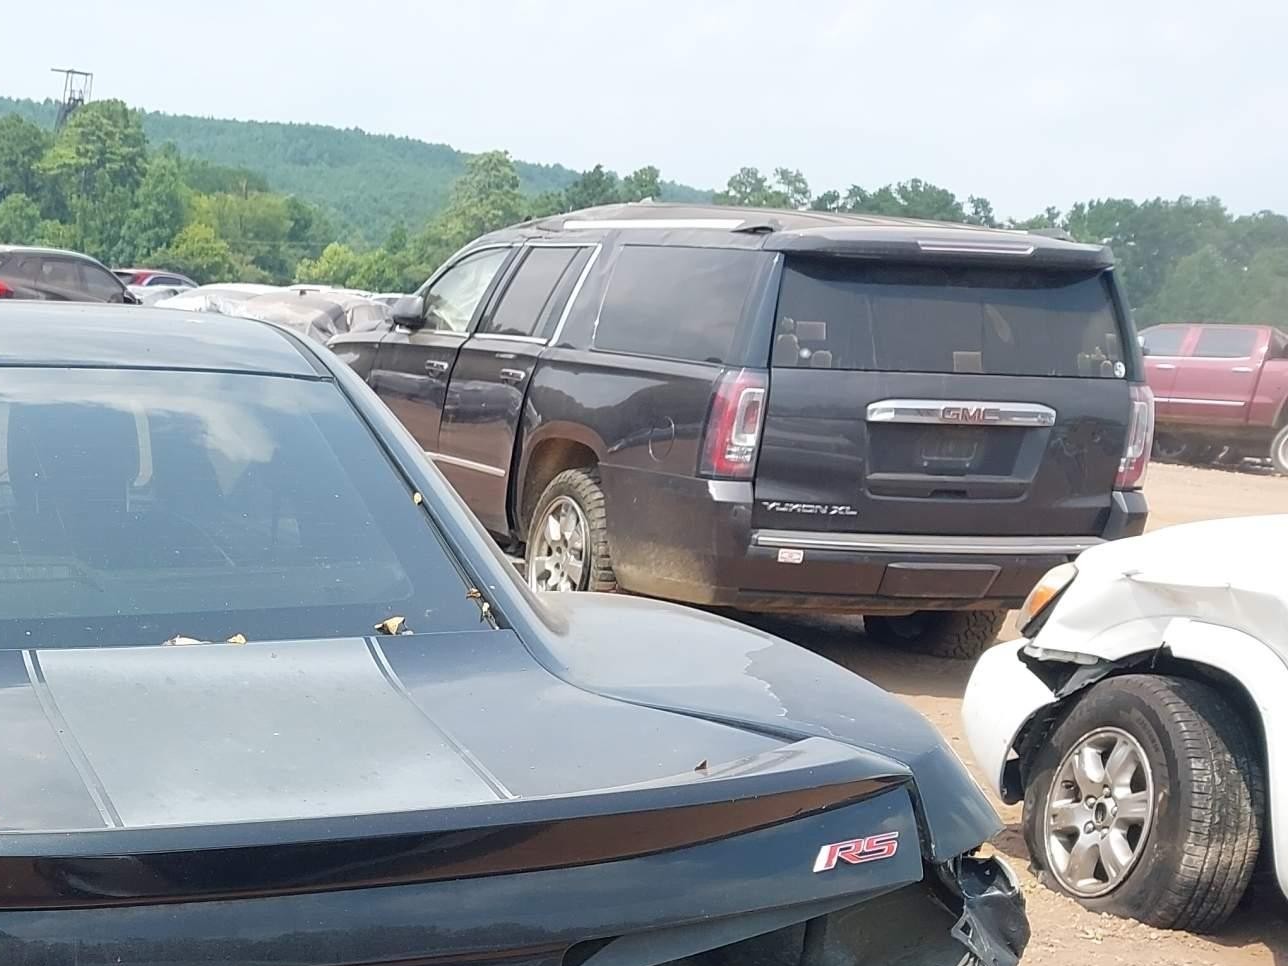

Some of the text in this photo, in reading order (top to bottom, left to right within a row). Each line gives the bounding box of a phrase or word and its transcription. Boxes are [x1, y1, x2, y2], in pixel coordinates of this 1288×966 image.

[940, 407, 1001, 422] GMC
[761, 501, 858, 515] YUKON XL
[812, 831, 900, 873] RS
